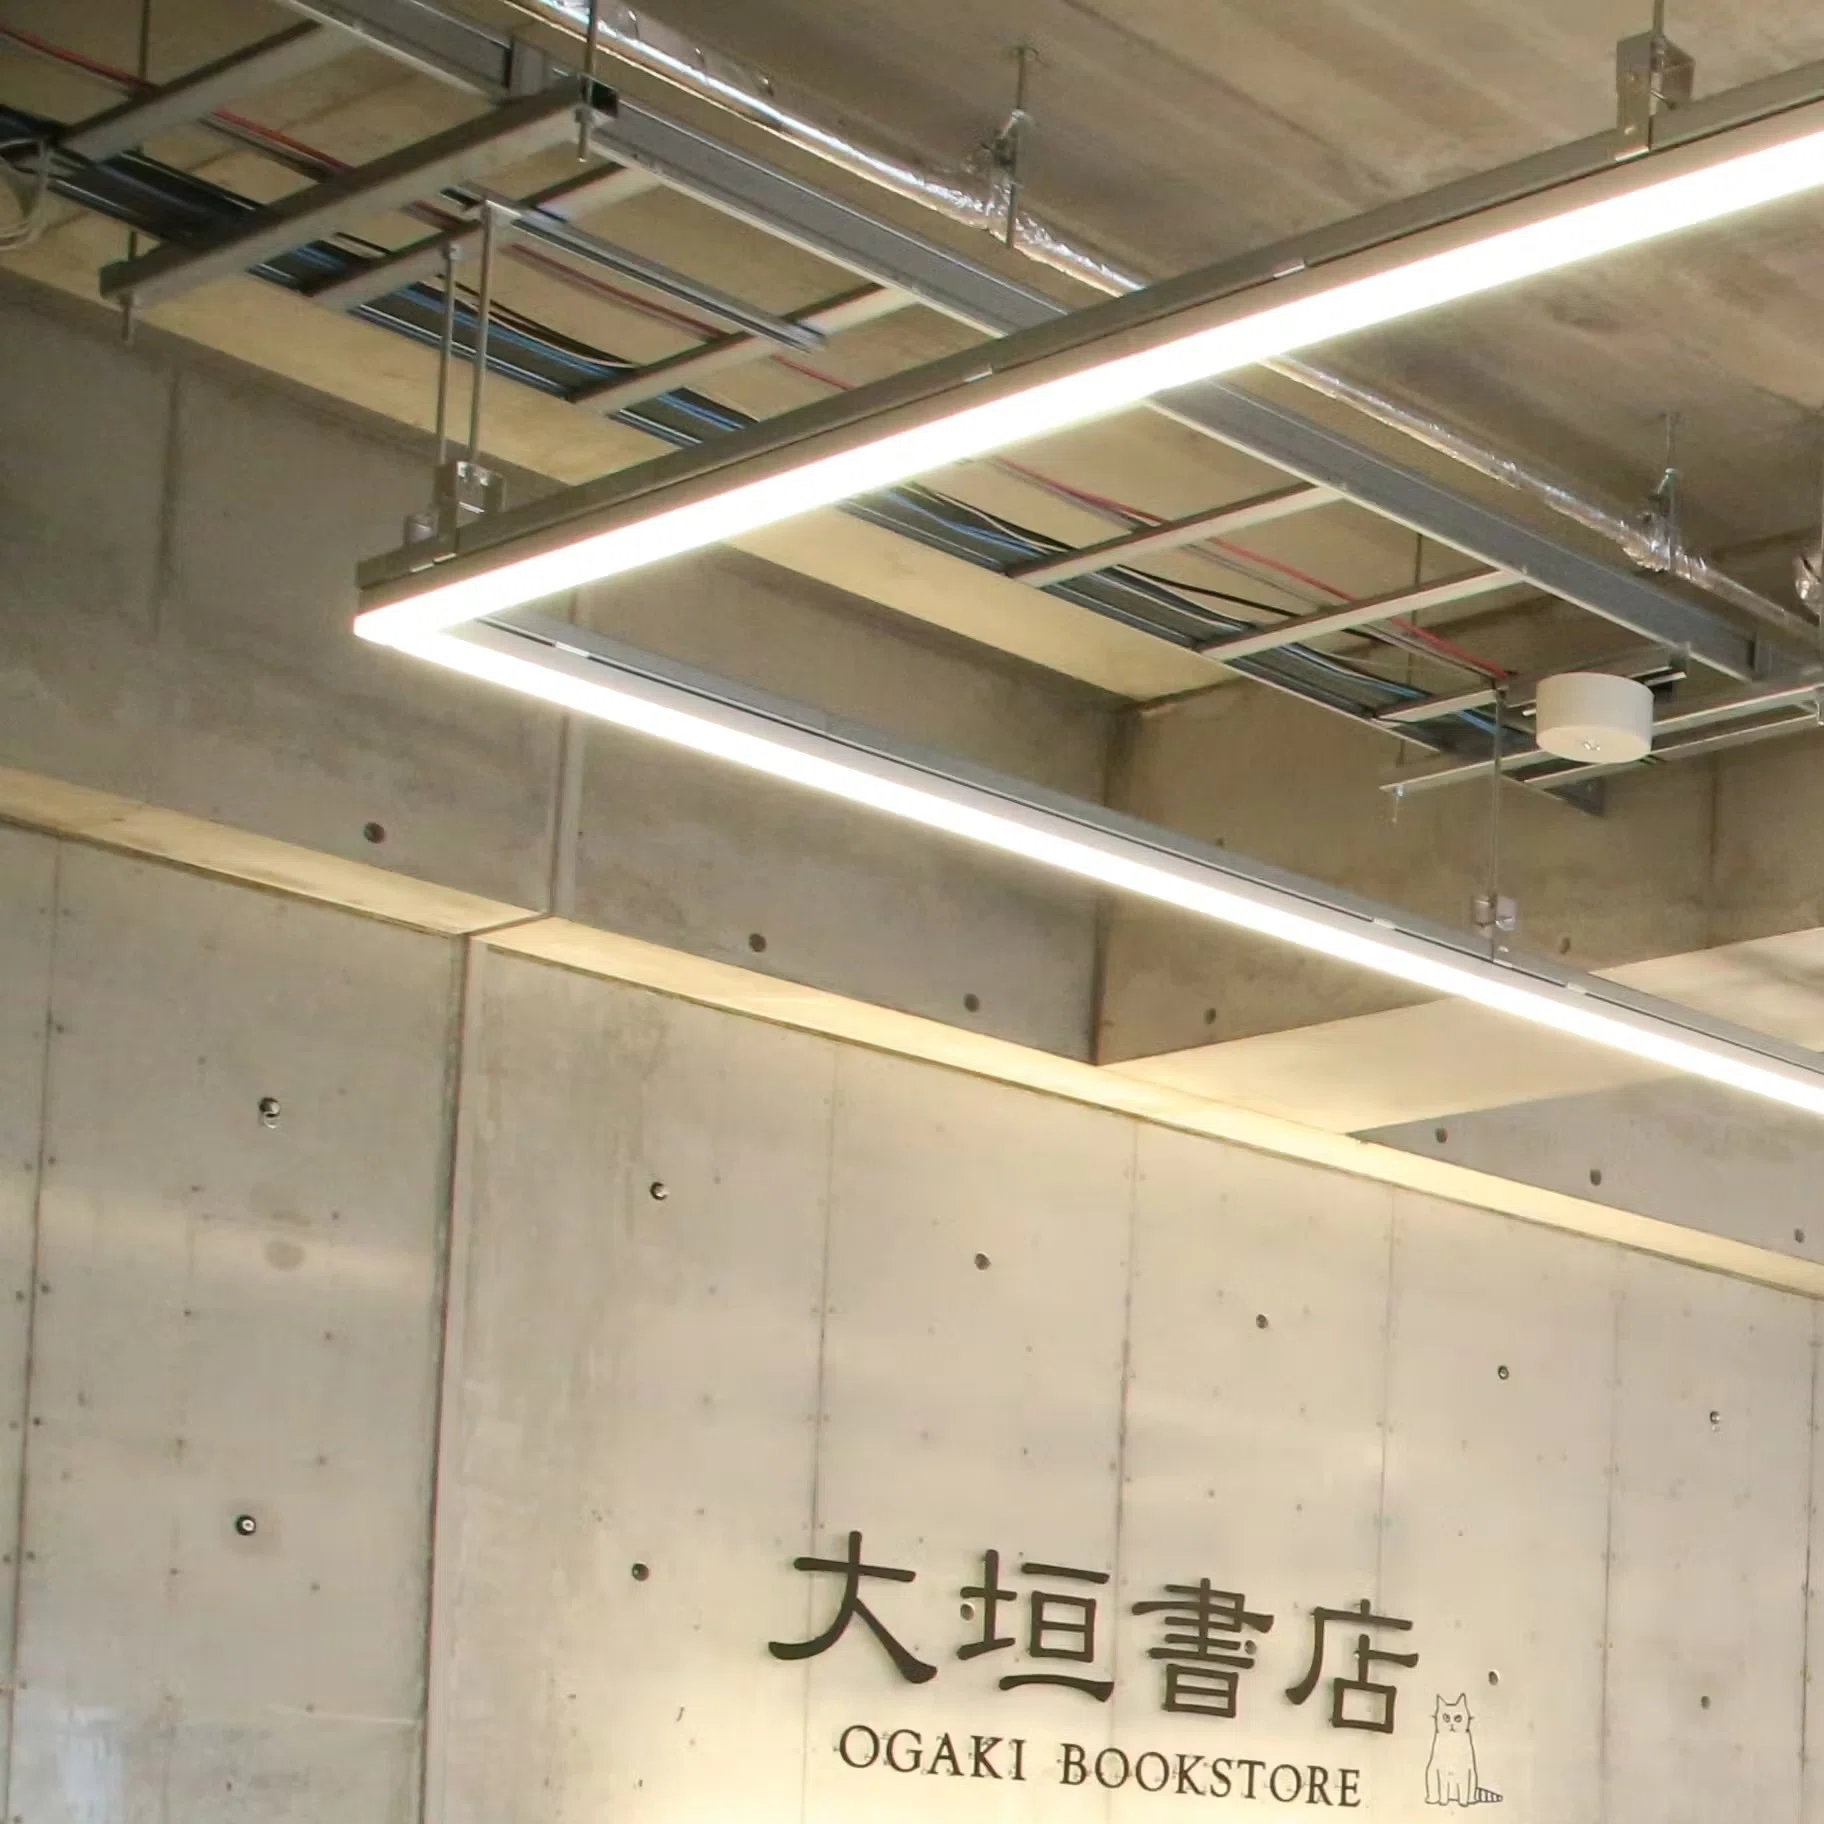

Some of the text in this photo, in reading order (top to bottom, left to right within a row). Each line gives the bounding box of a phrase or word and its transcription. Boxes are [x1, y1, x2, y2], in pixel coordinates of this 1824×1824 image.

[768, 1531, 1420, 1735] 大垣書店
[838, 1723, 1363, 1809] OGAKI BOOKSTORE
